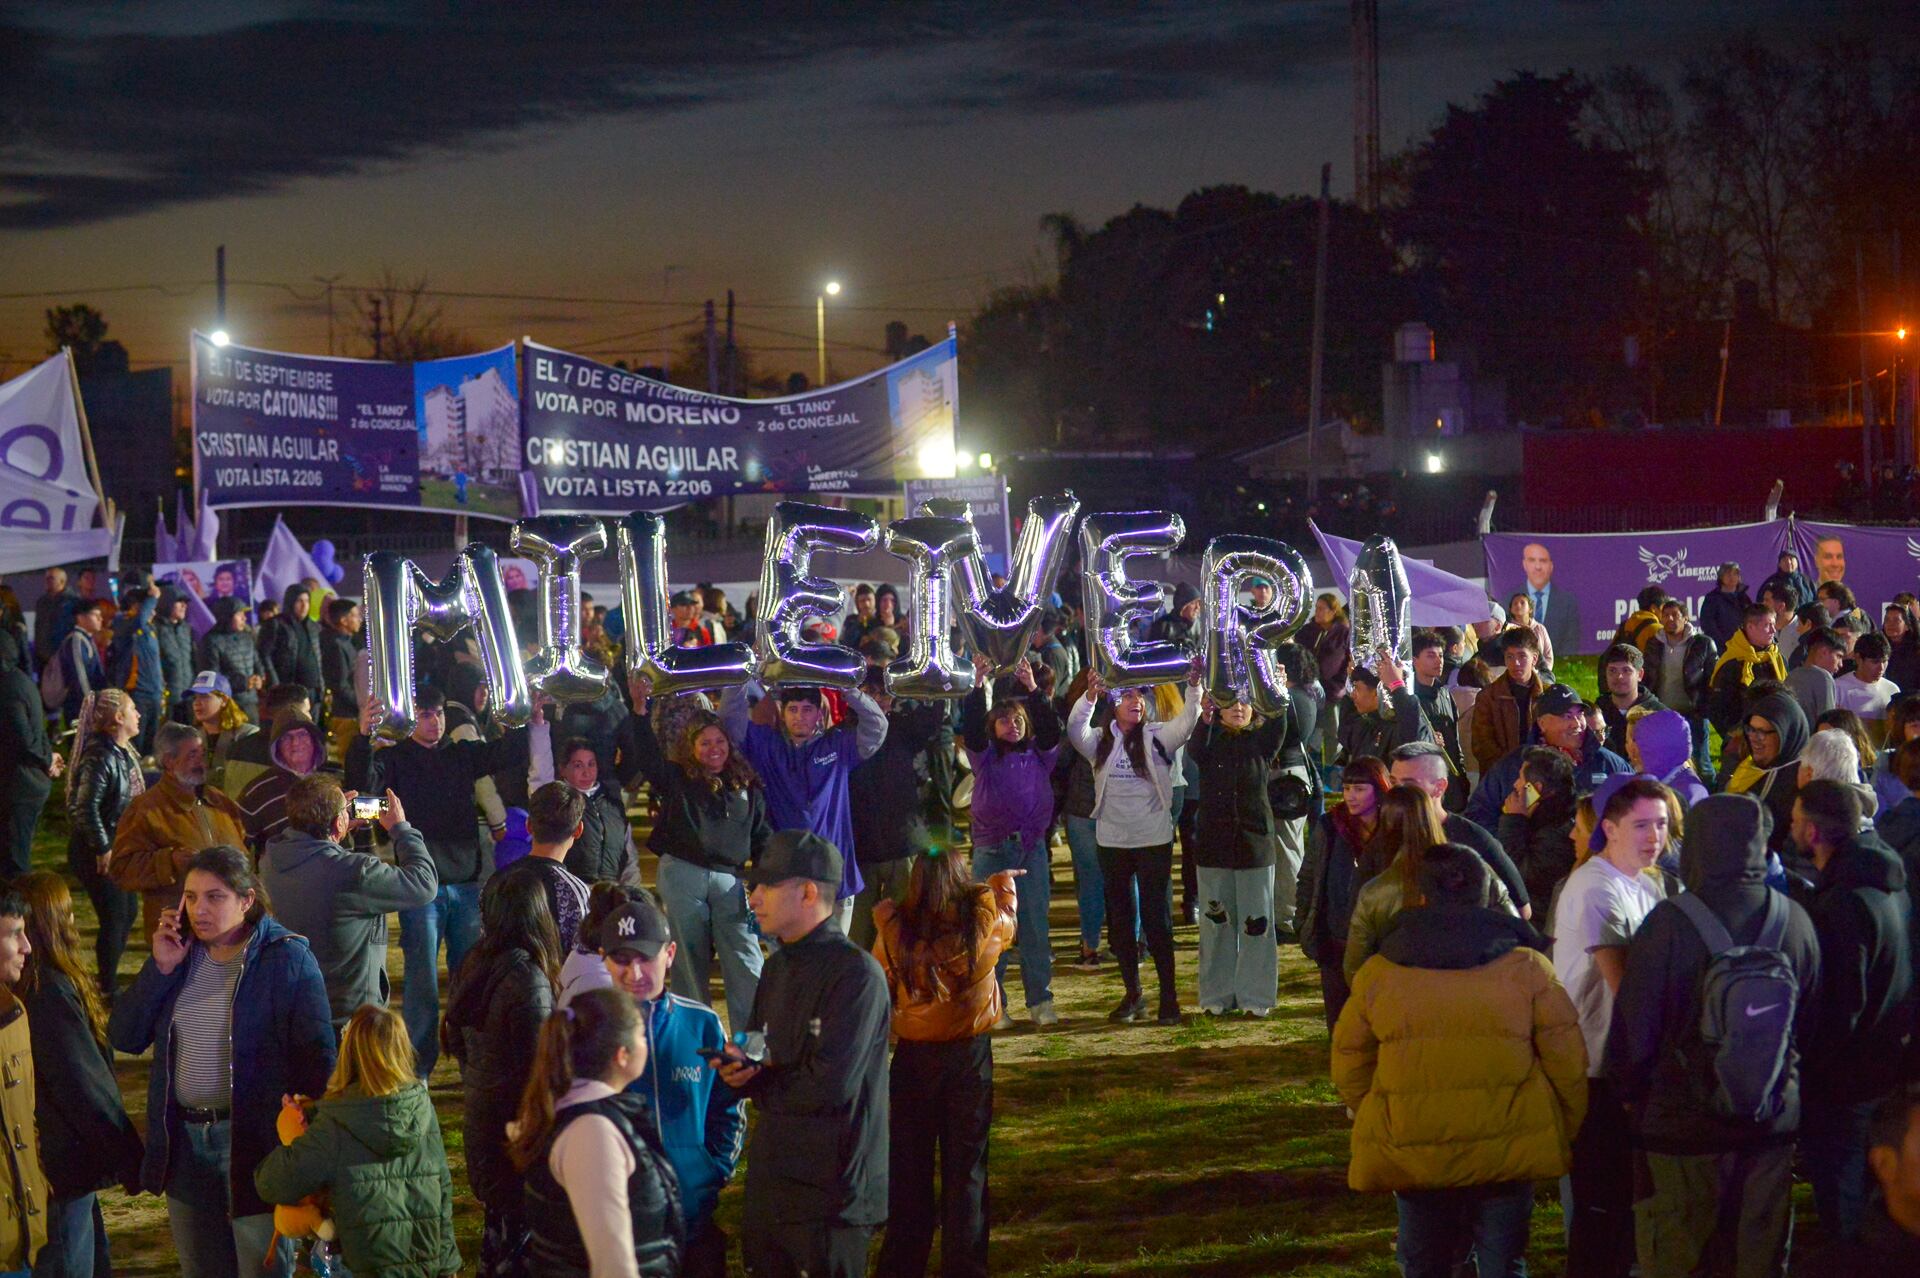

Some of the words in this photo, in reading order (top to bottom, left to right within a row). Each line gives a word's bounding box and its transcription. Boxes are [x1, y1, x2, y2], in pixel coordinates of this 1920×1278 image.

[226, 358, 232, 378] 7
[235, 360, 252, 381] DE
[254, 363, 333, 391] SEPTIEMBRE
[536, 358, 558, 382] EL
[563, 364, 573, 384] 7
[577, 367, 604, 388] DE
[608, 373, 728, 405] SEPTIEMB
[206, 388, 235, 406] VOTA
[237, 391, 260, 409] POR
[535, 391, 579, 414] VOTA
[582, 398, 617, 418] POR
[626, 402, 740, 425] MORENO
[351, 418, 356, 428] 2
[370, 419, 418, 430] CONCEJAL
[758, 421, 765, 432] 2
[768, 420, 784, 431] do
[788, 412, 859, 430] CONCEJAL
[198, 432, 268, 458] CRISTIAN
[272, 435, 339, 462] AGUILAR
[526, 437, 630, 469] CRISTIAN
[636, 444, 739, 472] AGUILAR
[216, 468, 252, 486] VOTA
[253, 468, 290, 486] LISTA
[292, 469, 322, 486] 2206
[807, 464, 821, 473] LA
[808, 470, 858, 480] LIBERTAD
[544, 477, 597, 496] VOTA
[603, 479, 660, 496] LISTA
[666, 480, 712, 496] 2206
[808, 480, 849, 490] AVANZA
[1678, 566, 1720, 577] LIBERTA
